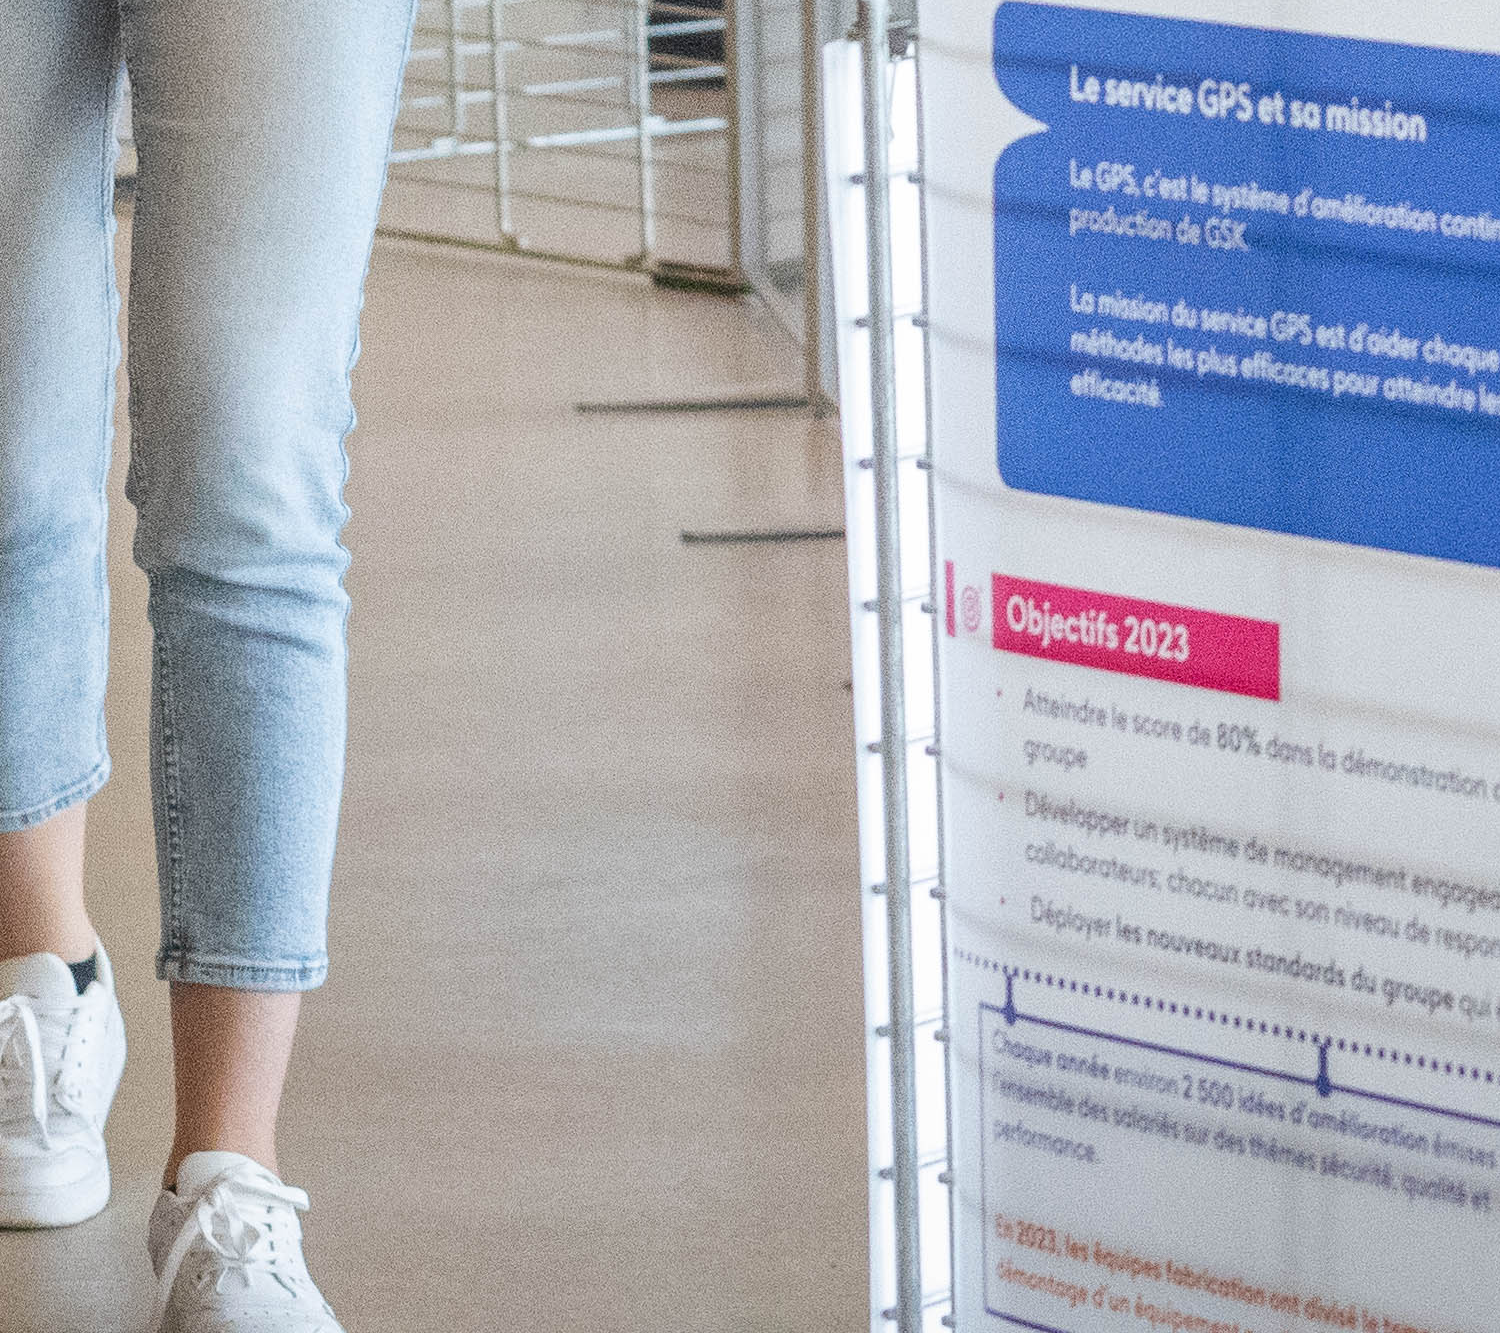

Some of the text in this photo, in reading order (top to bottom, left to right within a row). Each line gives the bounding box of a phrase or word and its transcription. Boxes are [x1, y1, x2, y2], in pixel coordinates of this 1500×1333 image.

[1069, 66, 1428, 143] Le service GPS et sa mission
[1069, 158, 1095, 190] Le
[1142, 169, 1189, 202] c'est
[1190, 175, 1211, 205] le
[1211, 181, 1291, 215] système
[1293, 187, 1438, 233] d'amélioration
[1006, 593, 1190, 664] Objectifs 2023
[1023, 738, 1089, 773] groupe
